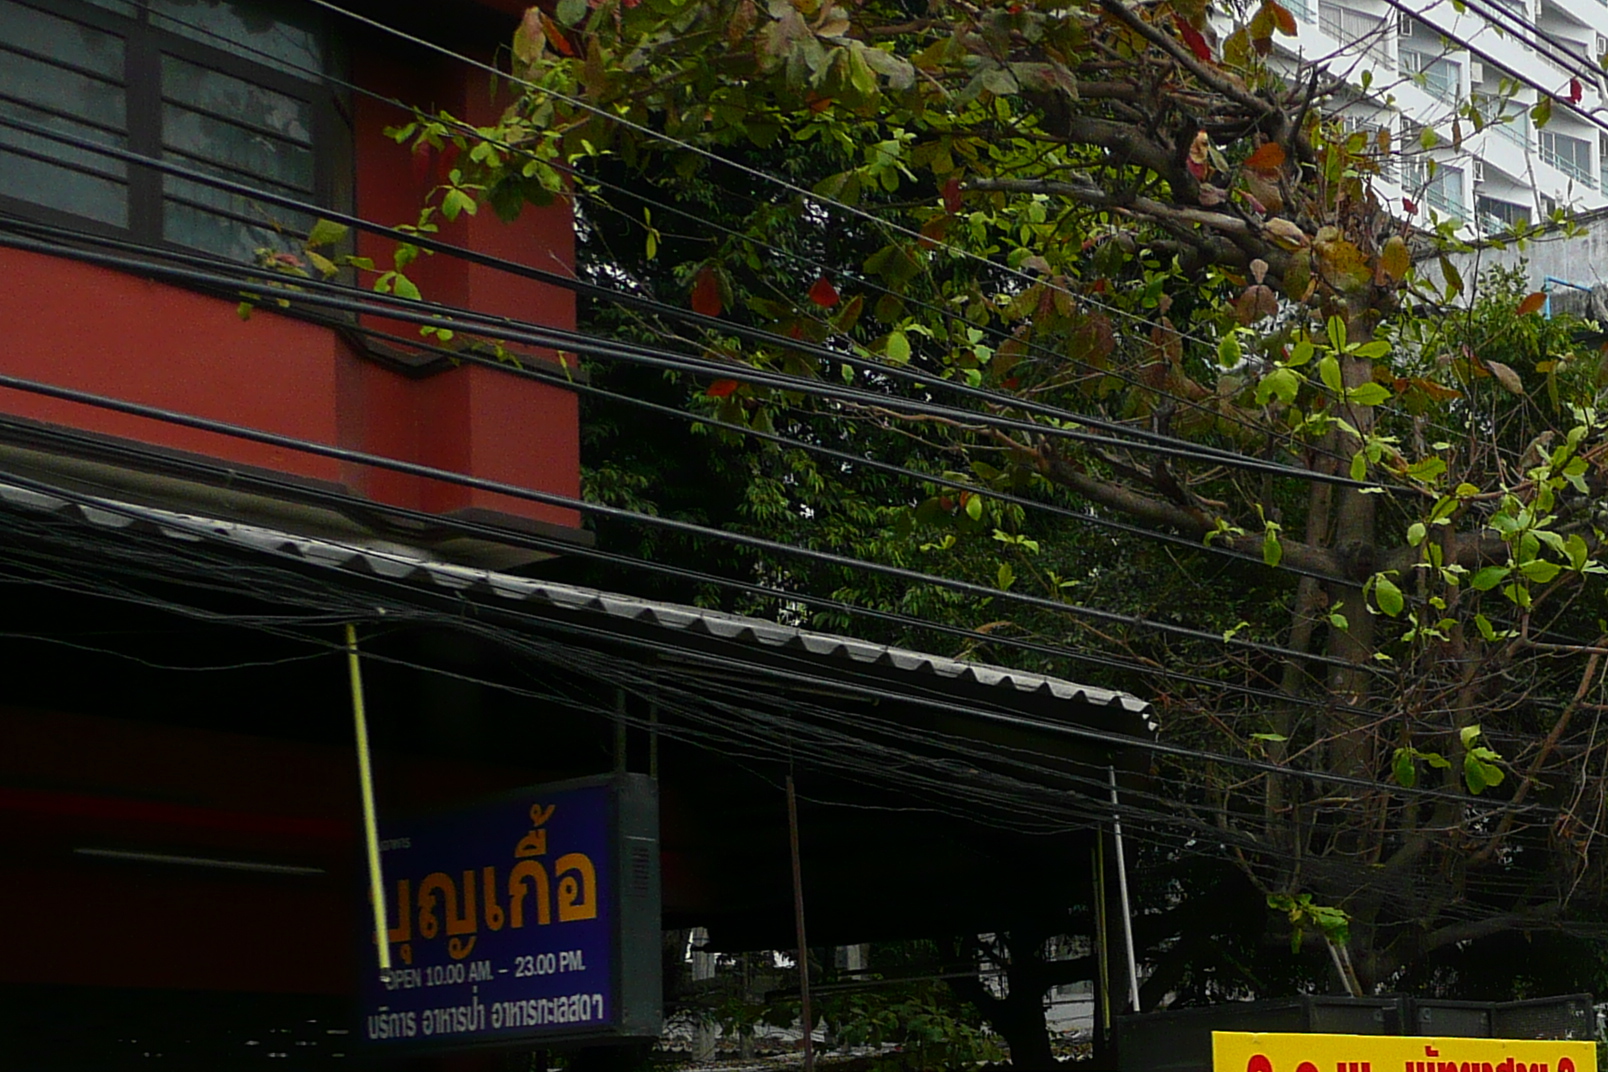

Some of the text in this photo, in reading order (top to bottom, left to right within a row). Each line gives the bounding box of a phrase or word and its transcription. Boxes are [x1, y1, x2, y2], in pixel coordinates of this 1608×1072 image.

[369, 803, 598, 964] บุญเกื้อ
[386, 968, 422, 991] OPEN
[426, 963, 465, 986] 10.00
[514, 953, 556, 977] 23.00
[367, 1006, 417, 1039] บริการ
[422, 985, 485, 1035] อาหารป่า
